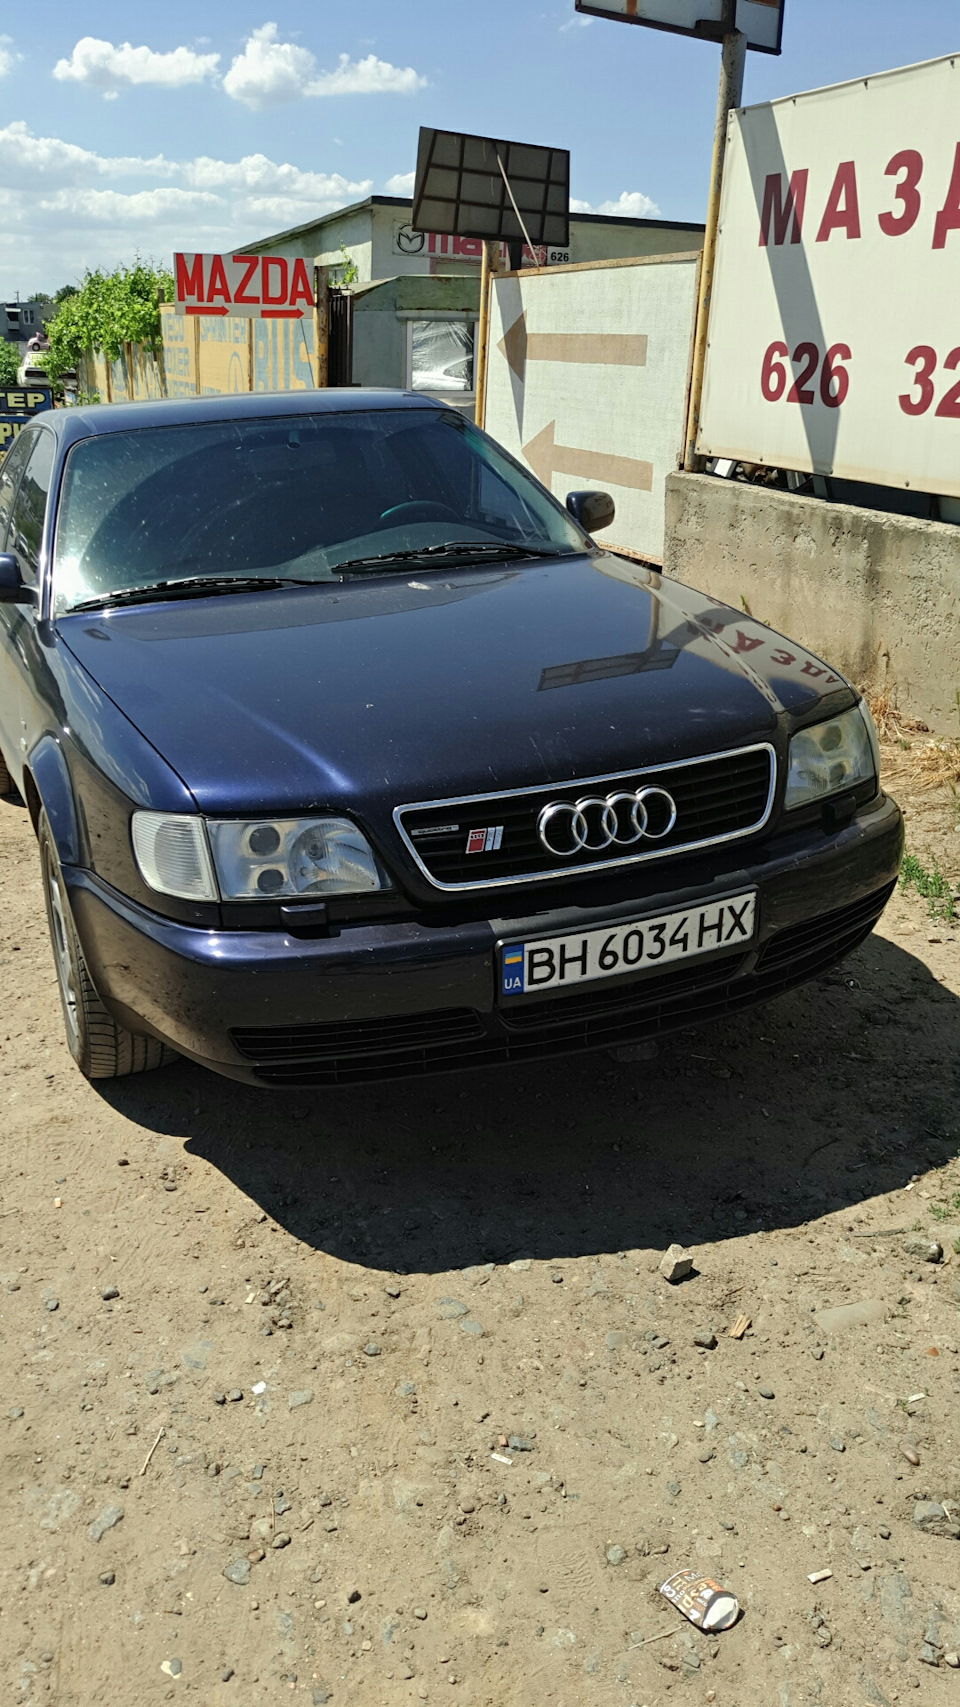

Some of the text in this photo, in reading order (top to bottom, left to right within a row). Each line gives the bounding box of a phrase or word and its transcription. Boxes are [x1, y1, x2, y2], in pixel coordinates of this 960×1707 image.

[176, 253, 315, 306] MAZDA
[550, 251, 569, 262] 626
[760, 340, 853, 409] 626
[527, 900, 751, 986] BH 6034 HX
[504, 976, 522, 990] UA
